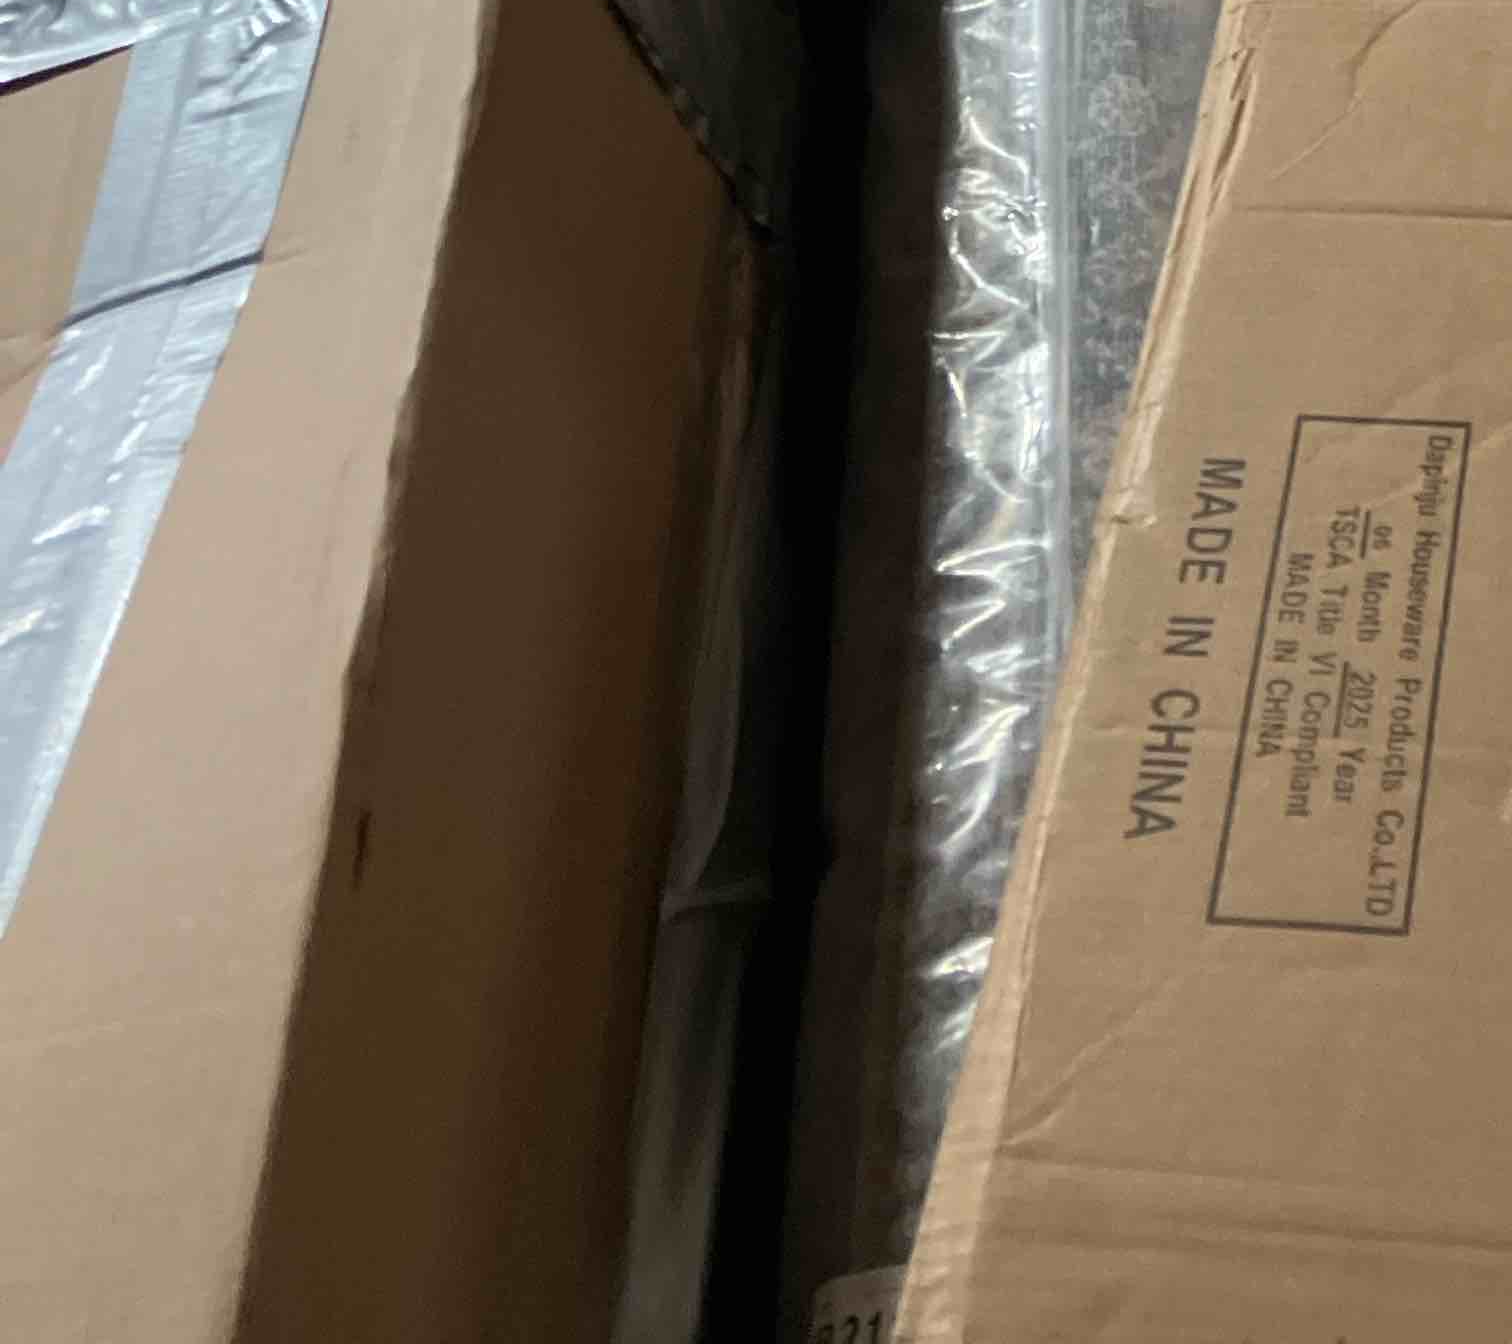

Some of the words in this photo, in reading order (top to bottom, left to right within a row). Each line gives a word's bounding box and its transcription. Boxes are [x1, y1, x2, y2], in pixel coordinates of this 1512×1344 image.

[1179, 456, 1248, 586] MADE
[1326, 507, 1361, 569] TSCA
[1277, 552, 1312, 624] MADE
[1316, 583, 1349, 636] Title
[1356, 570, 1392, 644] Month
[1398, 531, 1441, 663] Houseware
[1165, 617, 1215, 659] IN
[1273, 639, 1299, 664] IN
[1308, 654, 1337, 675] VI
[1255, 679, 1294, 758] CHINA
[1344, 672, 1377, 730] 2025
[1381, 677, 1424, 792] Products
[1123, 689, 1201, 840] CHINA
[1284, 690, 1331, 818] Compliant
[1334, 746, 1367, 804] Year
